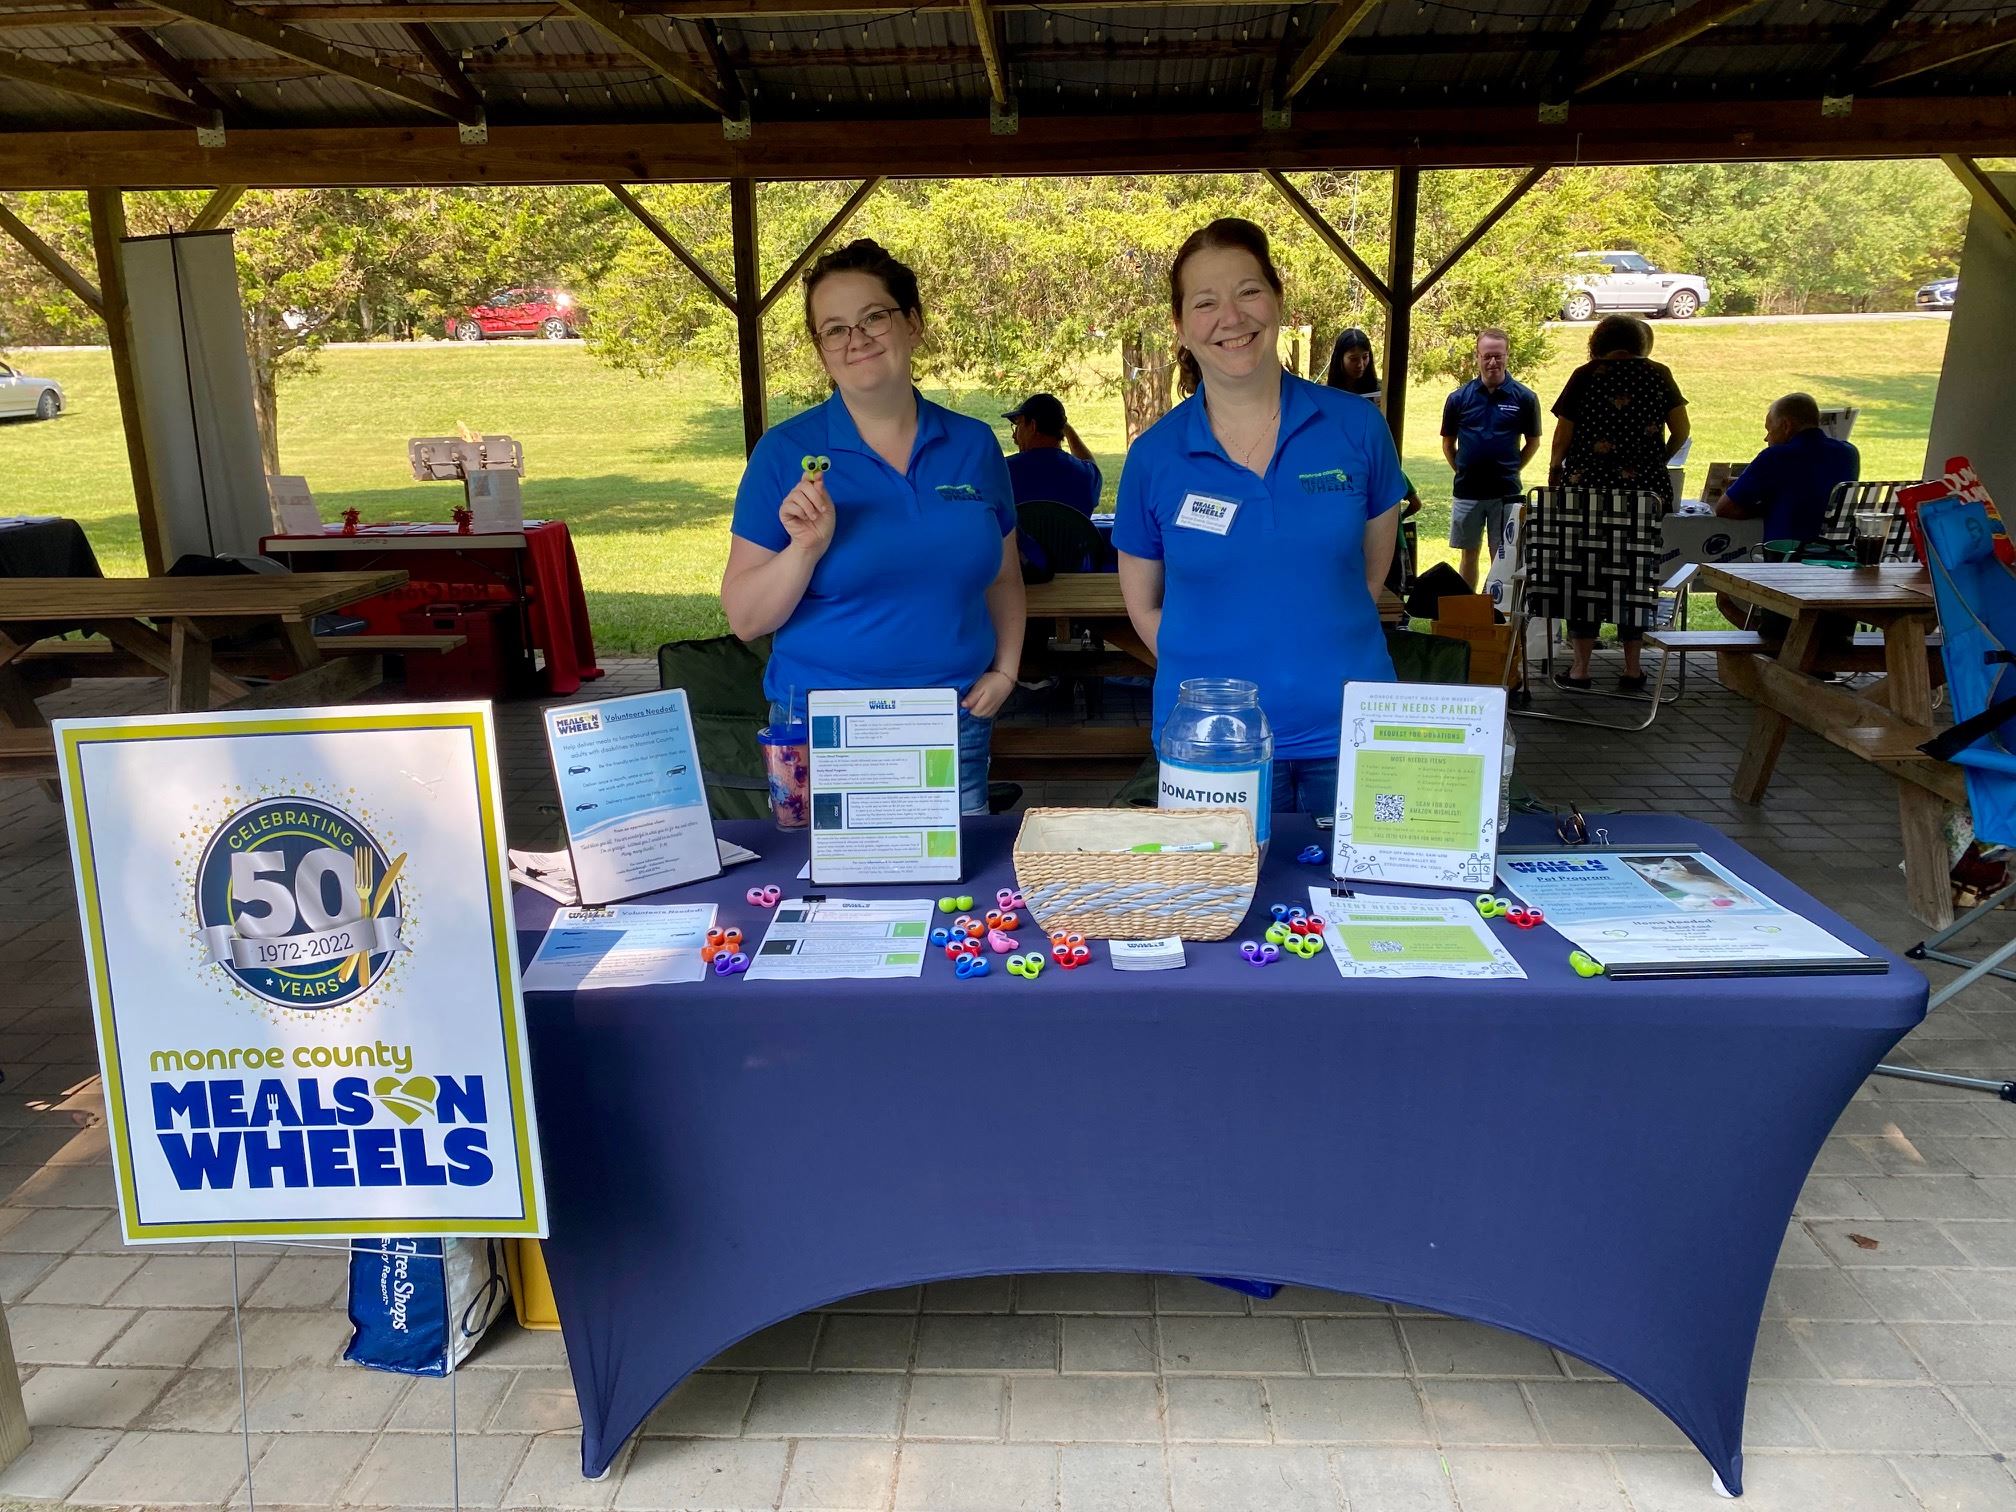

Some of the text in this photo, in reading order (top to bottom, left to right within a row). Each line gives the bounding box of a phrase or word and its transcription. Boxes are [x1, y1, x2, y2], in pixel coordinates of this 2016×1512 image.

[1192, 506, 1225, 519] WHEELS
[1193, 500, 1215, 510] MEALS
[604, 703, 676, 722] Volunteers Needed!
[1360, 701, 1484, 715] CLIENT NEEDS PANTRY
[556, 716, 584, 727] MEALS
[558, 721, 599, 734] WHEELS
[1379, 729, 1406, 737] REQUEST
[1422, 731, 1460, 739] DONATIONS
[1161, 781, 1247, 804] DONATIONS
[228, 810, 355, 850] CELEBRATING
[1513, 865, 1609, 873] WHEELS
[230, 849, 359, 938] 50
[258, 932, 354, 964] 1972-2022
[278, 978, 340, 998] YEARS
[149, 1041, 414, 1074] monroe county
[156, 1127, 494, 1191] WHEELS
[389, 1241, 417, 1330] Tree Shops
